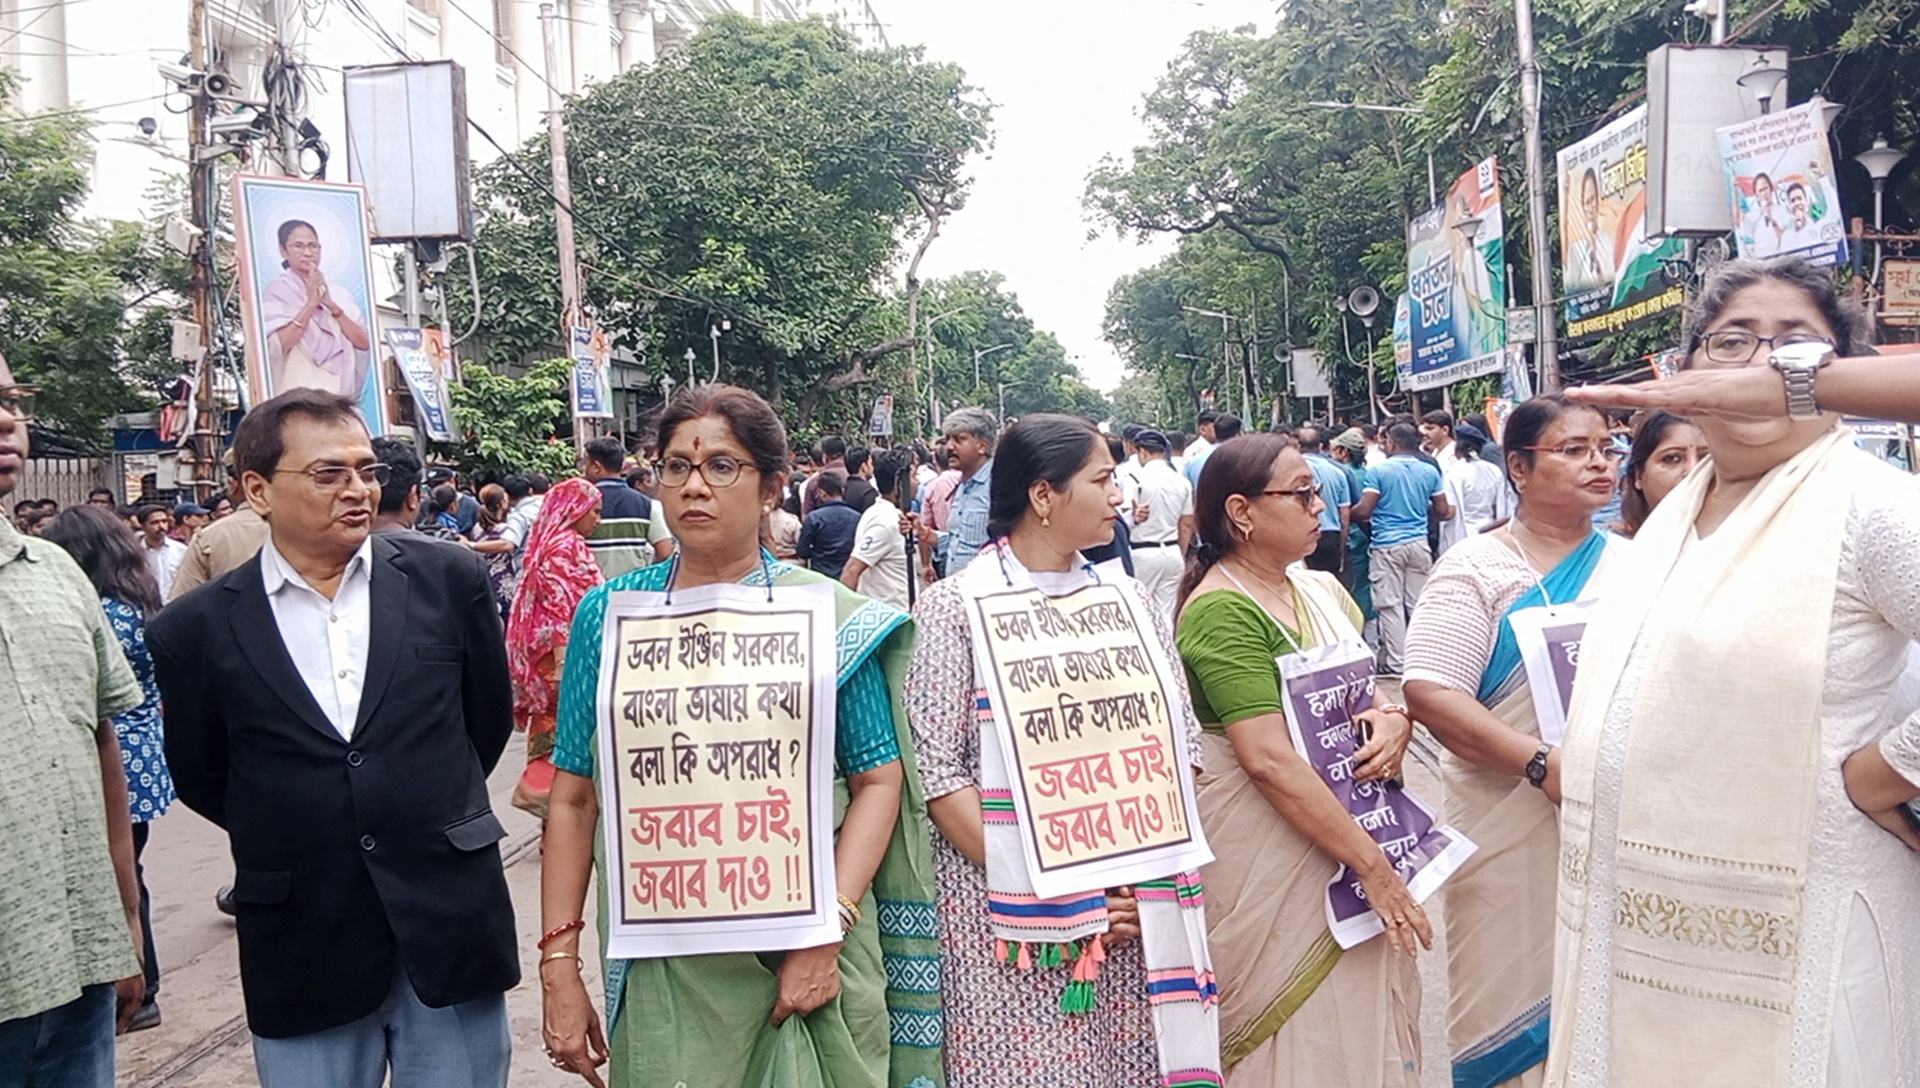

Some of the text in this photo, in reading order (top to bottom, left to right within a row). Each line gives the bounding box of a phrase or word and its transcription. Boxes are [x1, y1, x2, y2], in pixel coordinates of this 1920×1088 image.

[860, 535, 873, 551] 3
[627, 622, 805, 672] ডবল ইঞ্জিন সরকার,
[991, 611, 1036, 642] ডবল
[1070, 601, 1134, 638] সরকার,
[1004, 645, 1150, 693] বাংলা ভাষায় কথা
[623, 682, 801, 728] বাংলা ভাষায় কথা
[1020, 707, 1058, 745] বলা
[1058, 693, 1083, 739] কি
[1087, 693, 1151, 732] অপরাধ
[1304, 675, 1348, 717] हमारे
[628, 747, 666, 786] বলা
[672, 732, 698, 784] কি
[706, 738, 781, 781] অপরাধ
[1029, 733, 1174, 800] জবাব চাই,
[629, 786, 800, 851] জবাব চাই,
[1038, 802, 1116, 857] জবাব
[1116, 794, 1165, 846] দাও
[630, 859, 707, 912] জবাব
[718, 856, 770, 911] দাও
